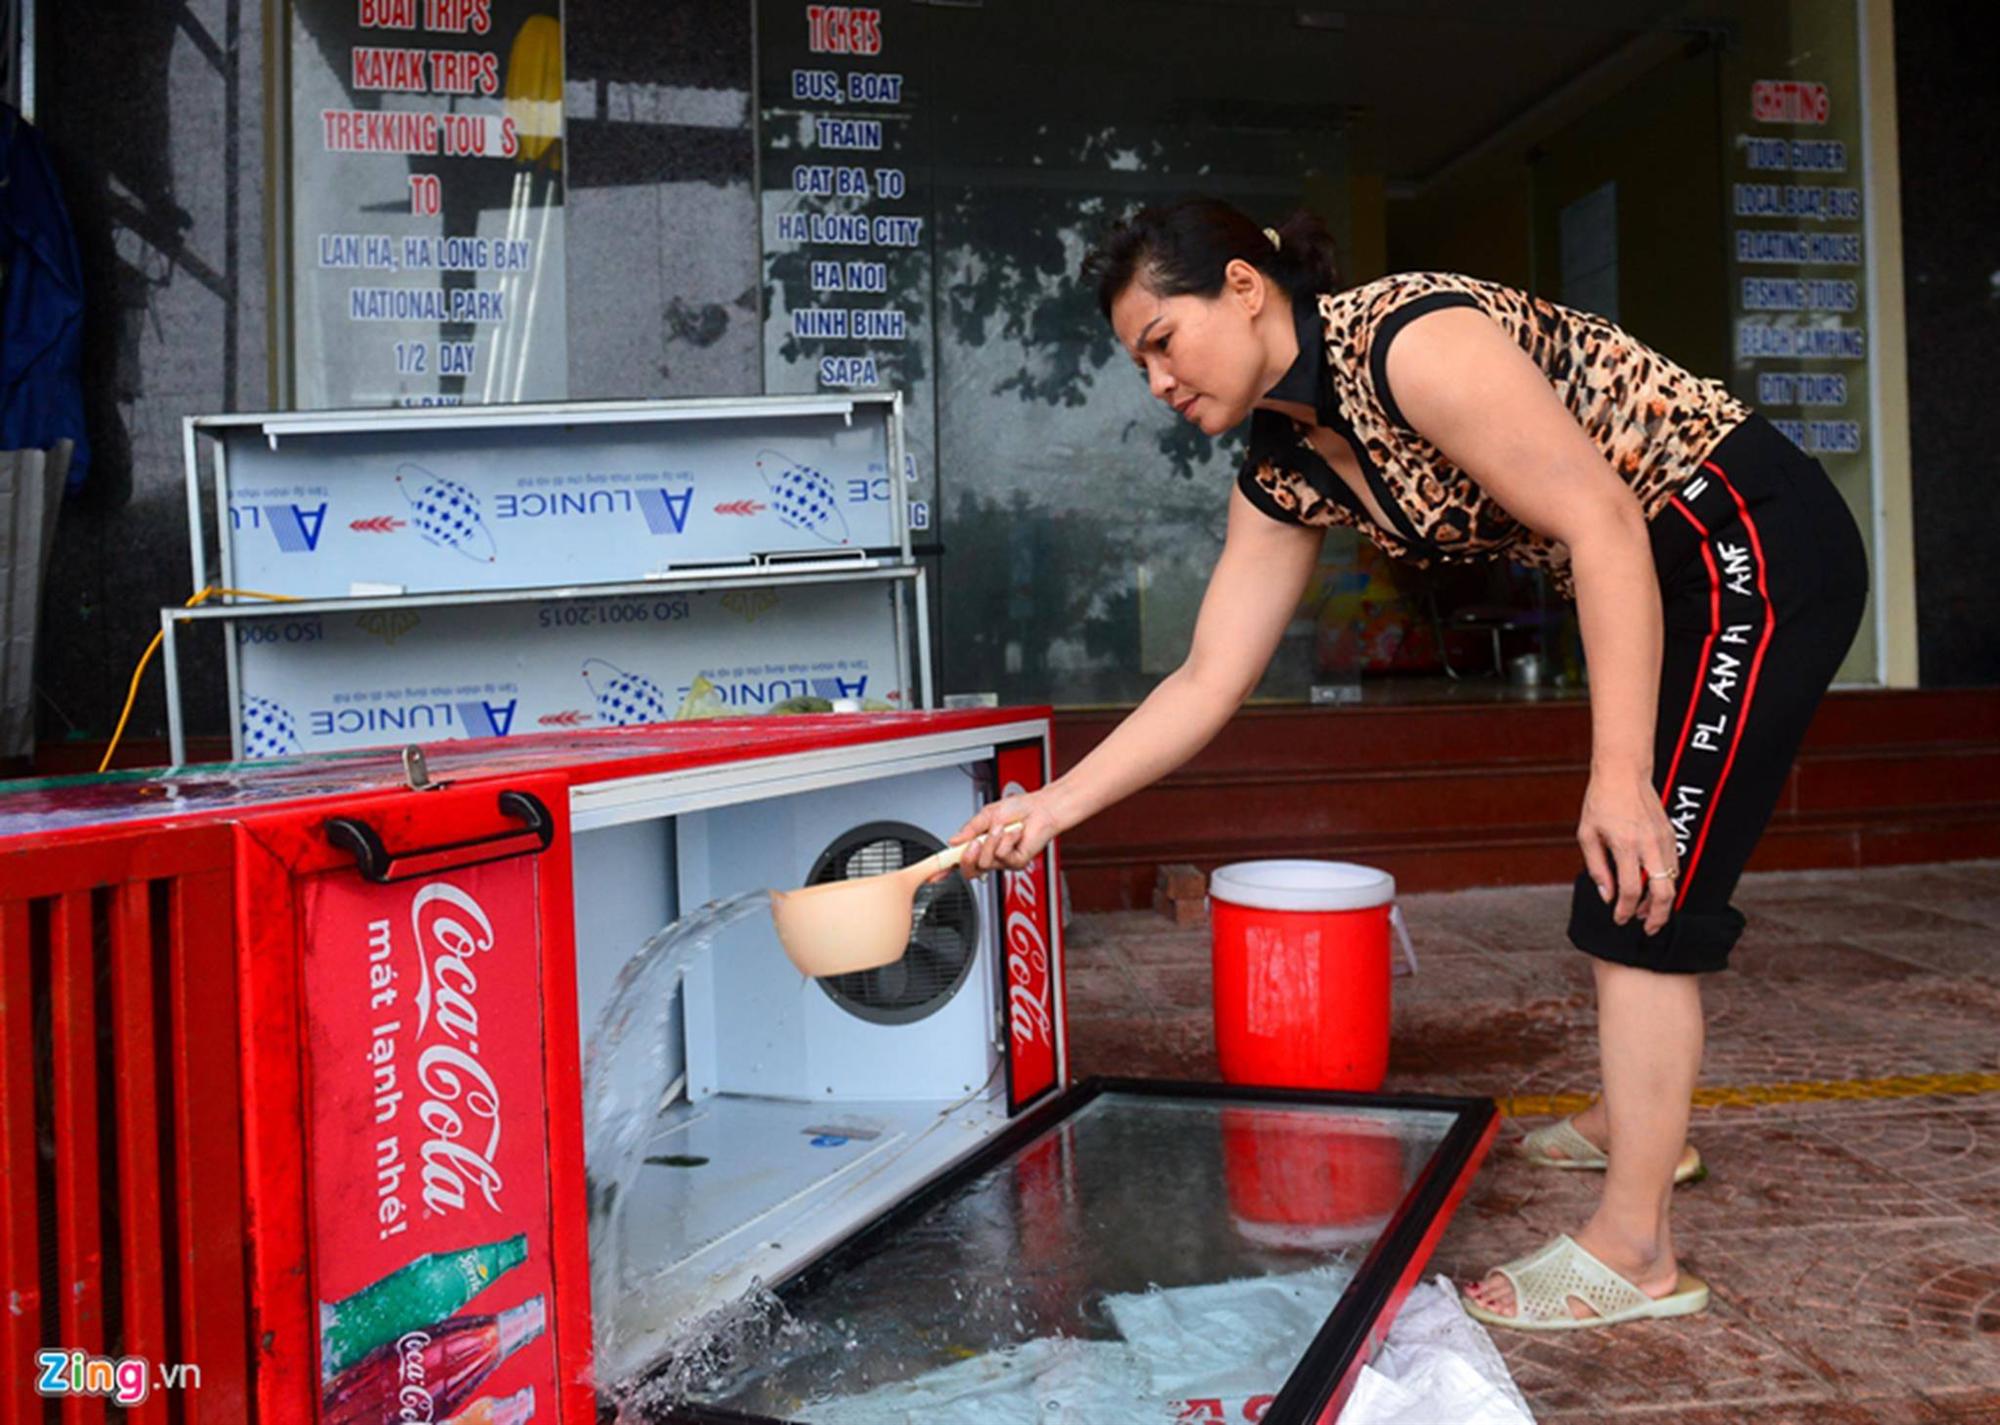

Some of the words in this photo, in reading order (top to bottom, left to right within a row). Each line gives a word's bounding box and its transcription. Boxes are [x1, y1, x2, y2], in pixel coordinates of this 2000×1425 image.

[359, 0, 415, 28] BOAT
[423, 0, 491, 34] TRIPS
[807, 7, 881, 54] TICKETS
[353, 48, 426, 90] KAYAK
[430, 51, 498, 93] TRIPS
[793, 70, 845, 103] BUS,
[849, 73, 902, 102] BOAT
[323, 110, 438, 154] TREKKING
[443, 114, 518, 158] TOUS
[818, 119, 882, 150] TRAIN
[1747, 138, 1788, 169] TOUR
[411, 175, 441, 215] TO
[794, 166, 832, 194] CAT
[837, 167, 867, 196] BA
[876, 169, 905, 198] TO
[777, 214, 808, 241] HA
[812, 214, 870, 244] LONG
[873, 217, 922, 245] CITY
[319, 235, 360, 268] LAN
[405, 238, 433, 268] HA
[437, 239, 488, 269] LONG
[494, 240, 530, 269] BAY
[812, 262, 844, 291] HA
[848, 264, 887, 291] NOI
[351, 287, 448, 320] NATIONAL
[452, 290, 505, 321] PARK
[1743, 277, 1804, 310] FISHING
[1807, 280, 1857, 311] TOURS
[793, 309, 848, 338] NINH
[852, 310, 905, 339] BINH
[396, 343, 426, 373] 1/2
[438, 344, 475, 374] DAY
[820, 356, 877, 384] SAPA
[1758, 372, 1794, 406] CITY
[1796, 373, 1848, 406] TOURS
[1809, 420, 1860, 454] TOURS
[653, 601, 690, 621] ISO
[368, 919, 398, 1010] mát
[366, 1021, 406, 1124] lạnh
[376, 1136, 408, 1240] nhé!
